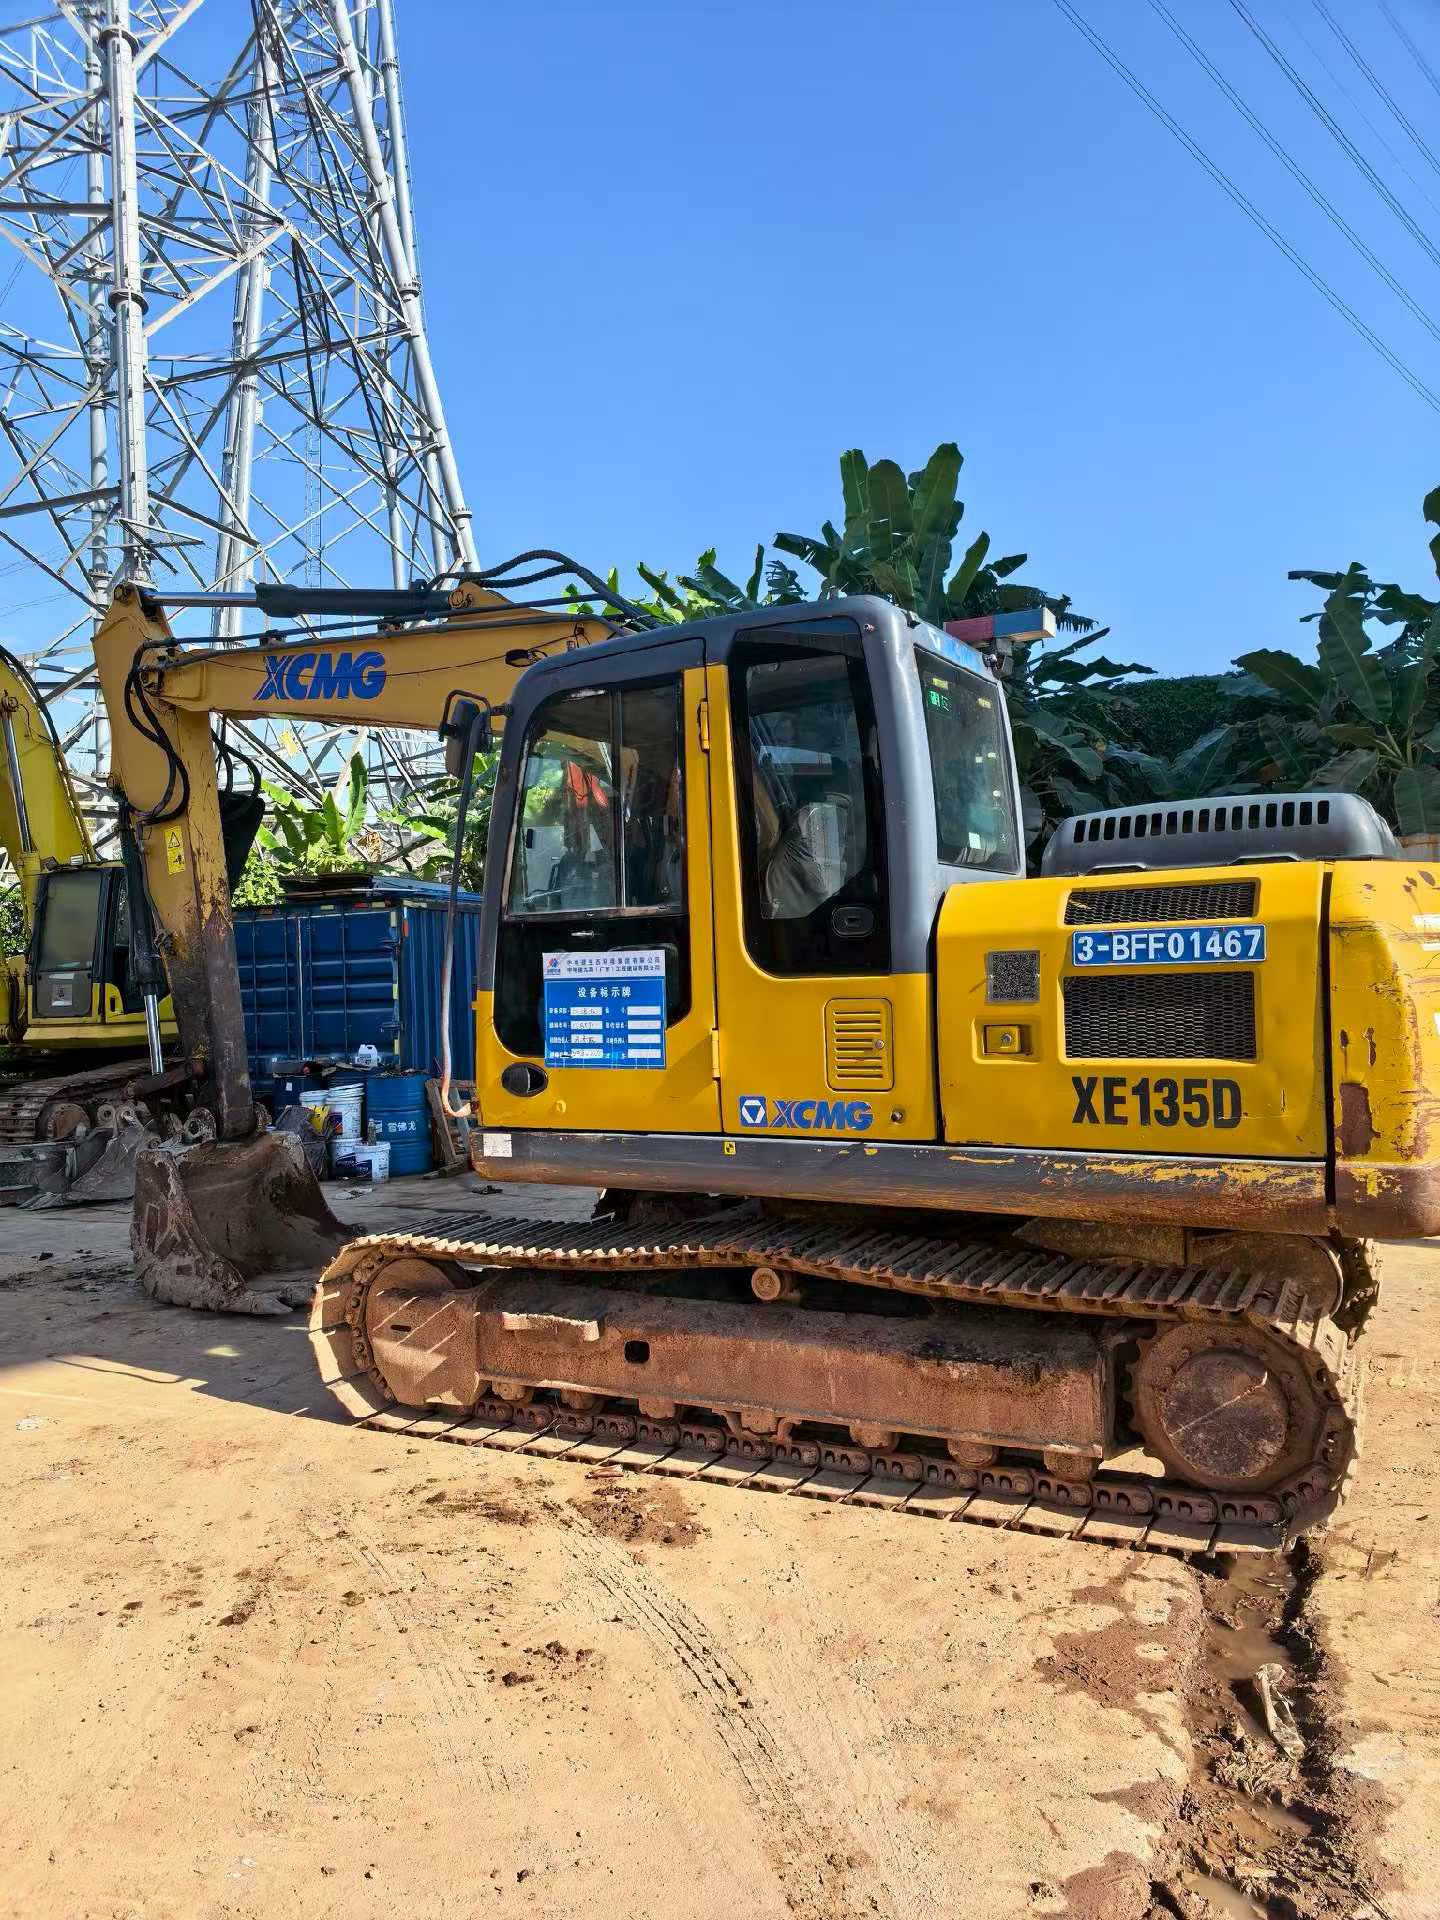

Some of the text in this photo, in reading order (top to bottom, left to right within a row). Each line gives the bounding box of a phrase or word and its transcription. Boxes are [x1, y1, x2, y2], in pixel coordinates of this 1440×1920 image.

[252, 651, 387, 700] XCMG
[1077, 928, 1261, 962] 3-BFF01467
[769, 1099, 874, 1131] XCMG
[1071, 1076, 1242, 1129] XE135D
